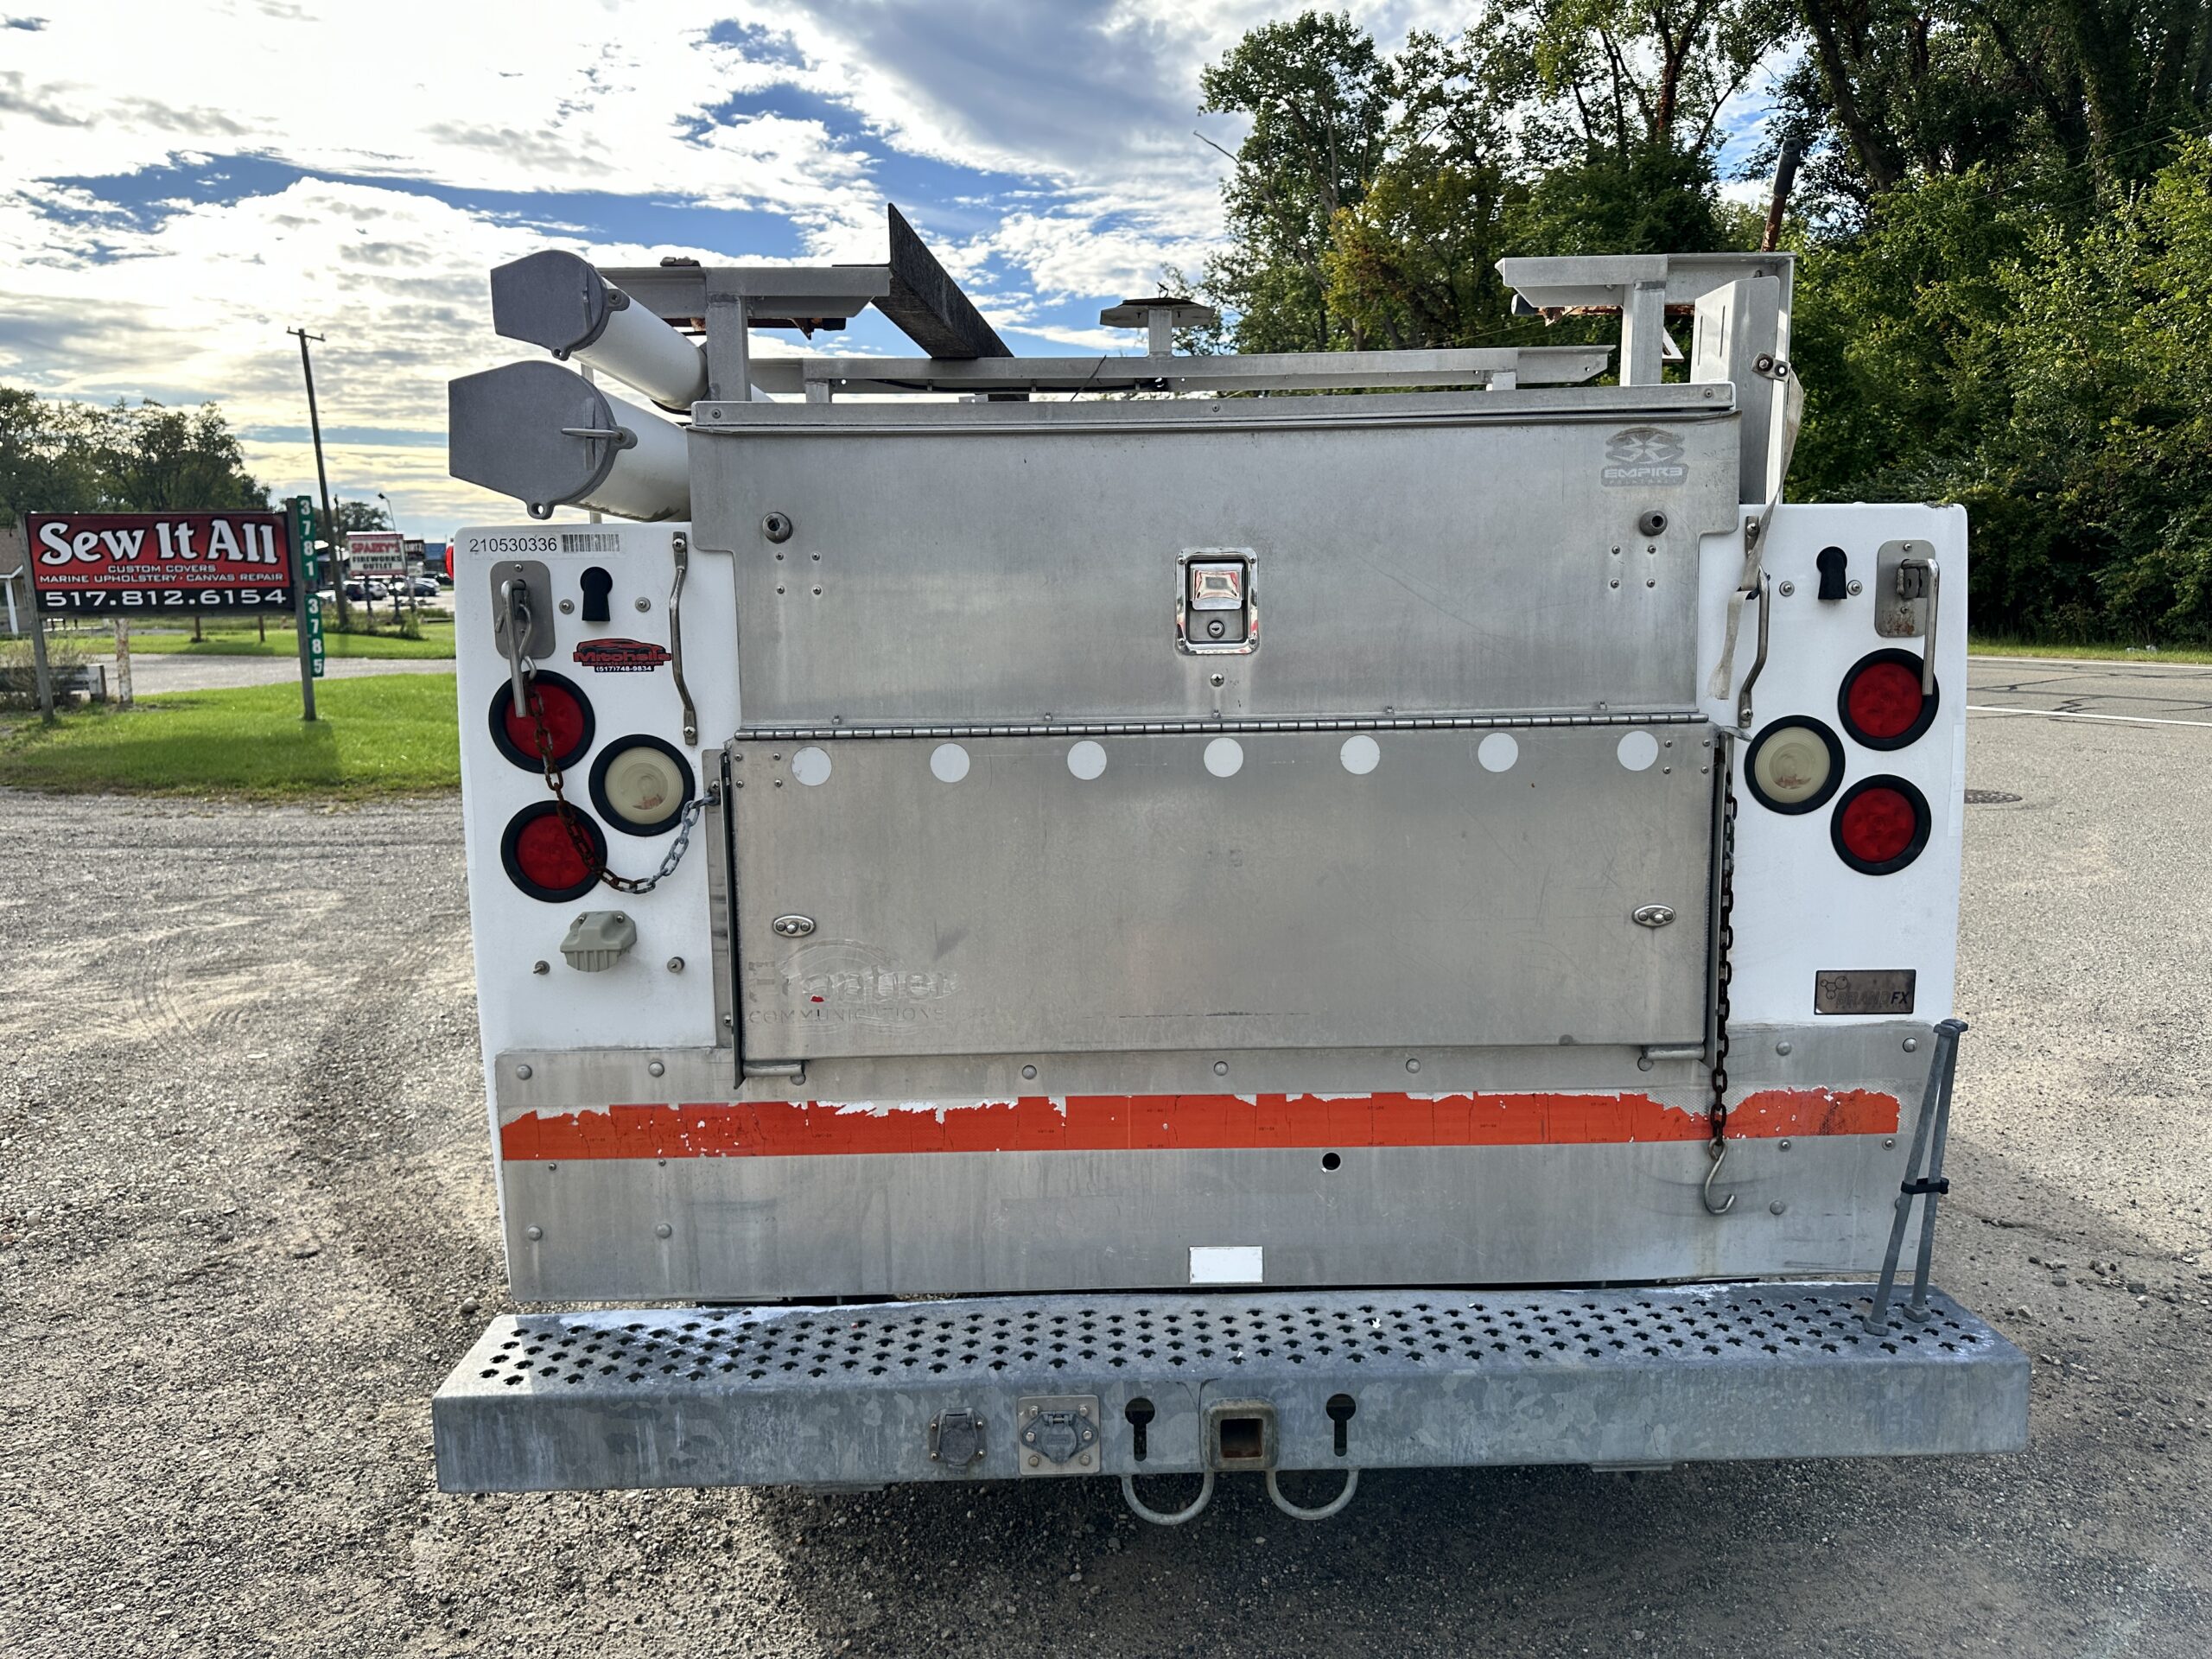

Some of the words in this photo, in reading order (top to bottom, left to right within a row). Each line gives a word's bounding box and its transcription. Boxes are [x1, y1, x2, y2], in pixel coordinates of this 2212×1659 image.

[39, 522, 145, 565] Sew
[156, 522, 198, 560] It
[207, 518, 278, 564] All
[469, 537, 557, 553] 210530336
[107, 564, 161, 574] CUSTOM
[166, 563, 217, 573] COVERS
[40, 575, 90, 583] MARINE
[94, 574, 177, 583] UPHOLSTERY
[186, 573, 235, 582] CANVAS
[239, 573, 283, 582] REPAIR
[46, 588, 287, 607] 517.812.6154
